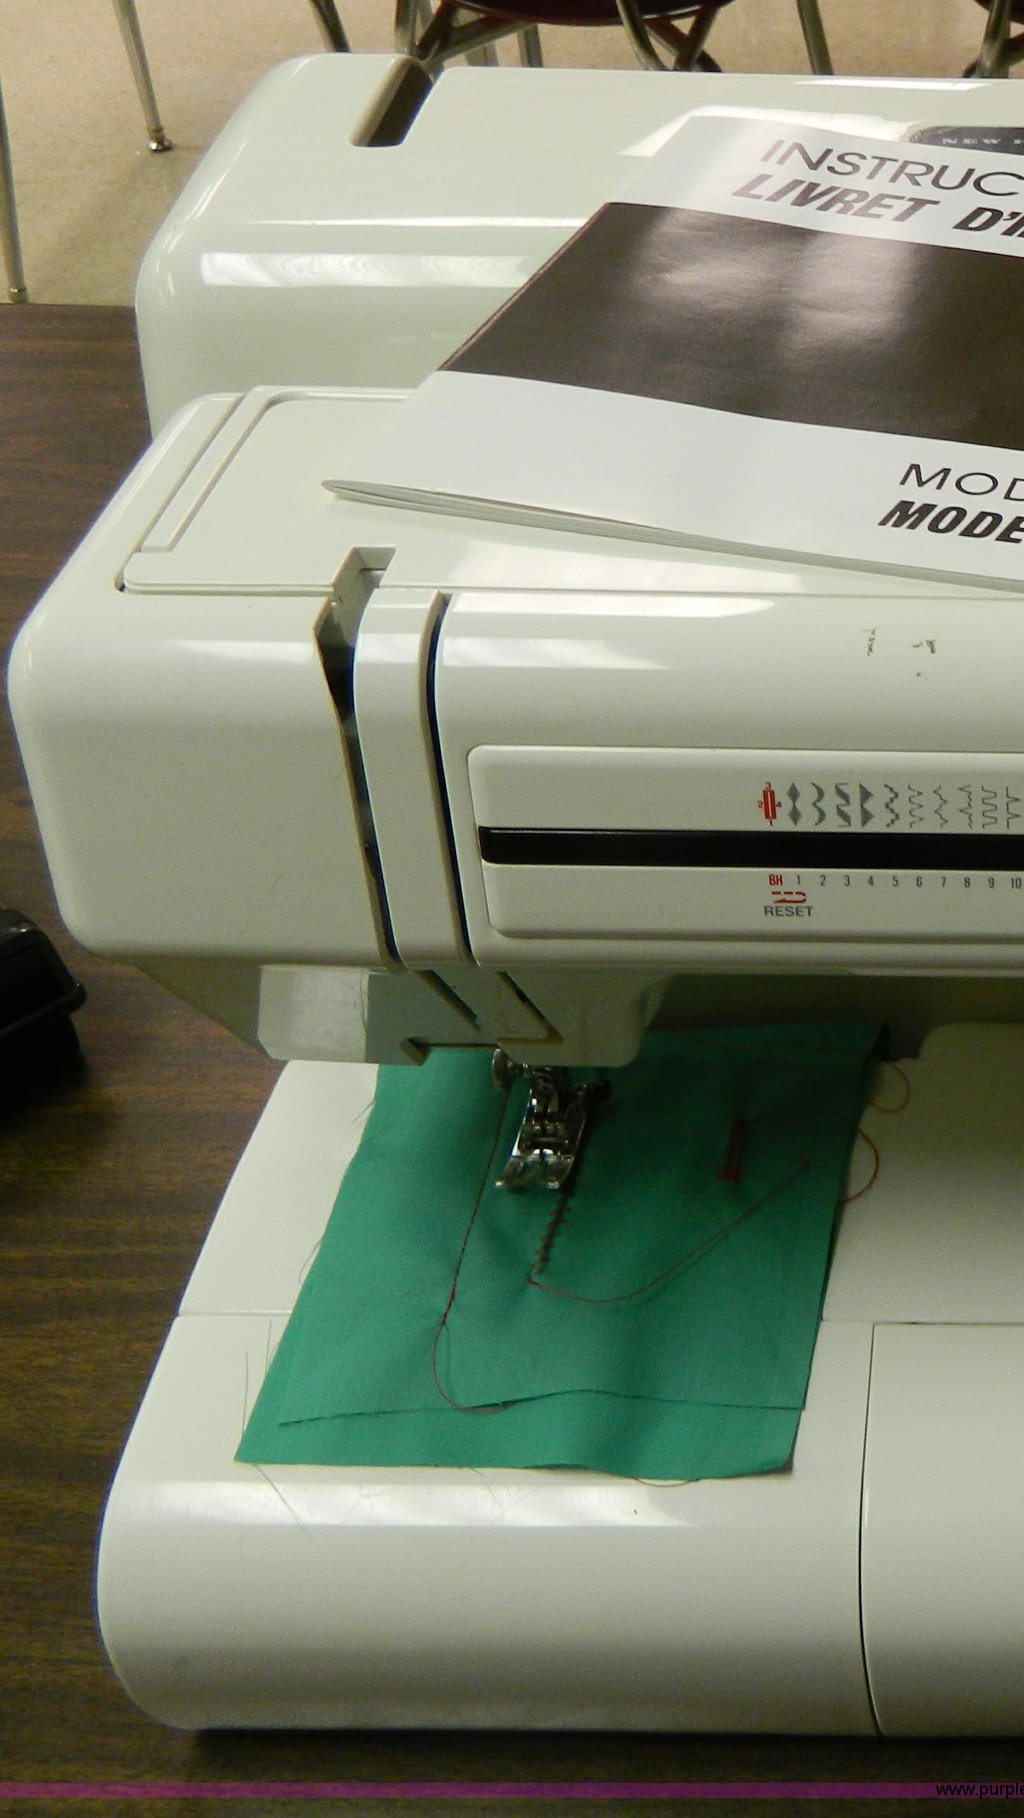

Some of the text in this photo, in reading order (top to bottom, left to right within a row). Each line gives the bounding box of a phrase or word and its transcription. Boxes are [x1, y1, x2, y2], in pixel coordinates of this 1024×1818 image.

[942, 137, 1000, 146] NEW
[731, 174, 940, 223] LIVRET
[892, 876, 899, 887] 5
[916, 877, 922, 887] 6
[941, 877, 946, 888] 7
[964, 877, 970, 888] 8
[989, 877, 995, 889] 9
[1011, 878, 1022, 889] 10
[764, 905, 813, 917] RESET
